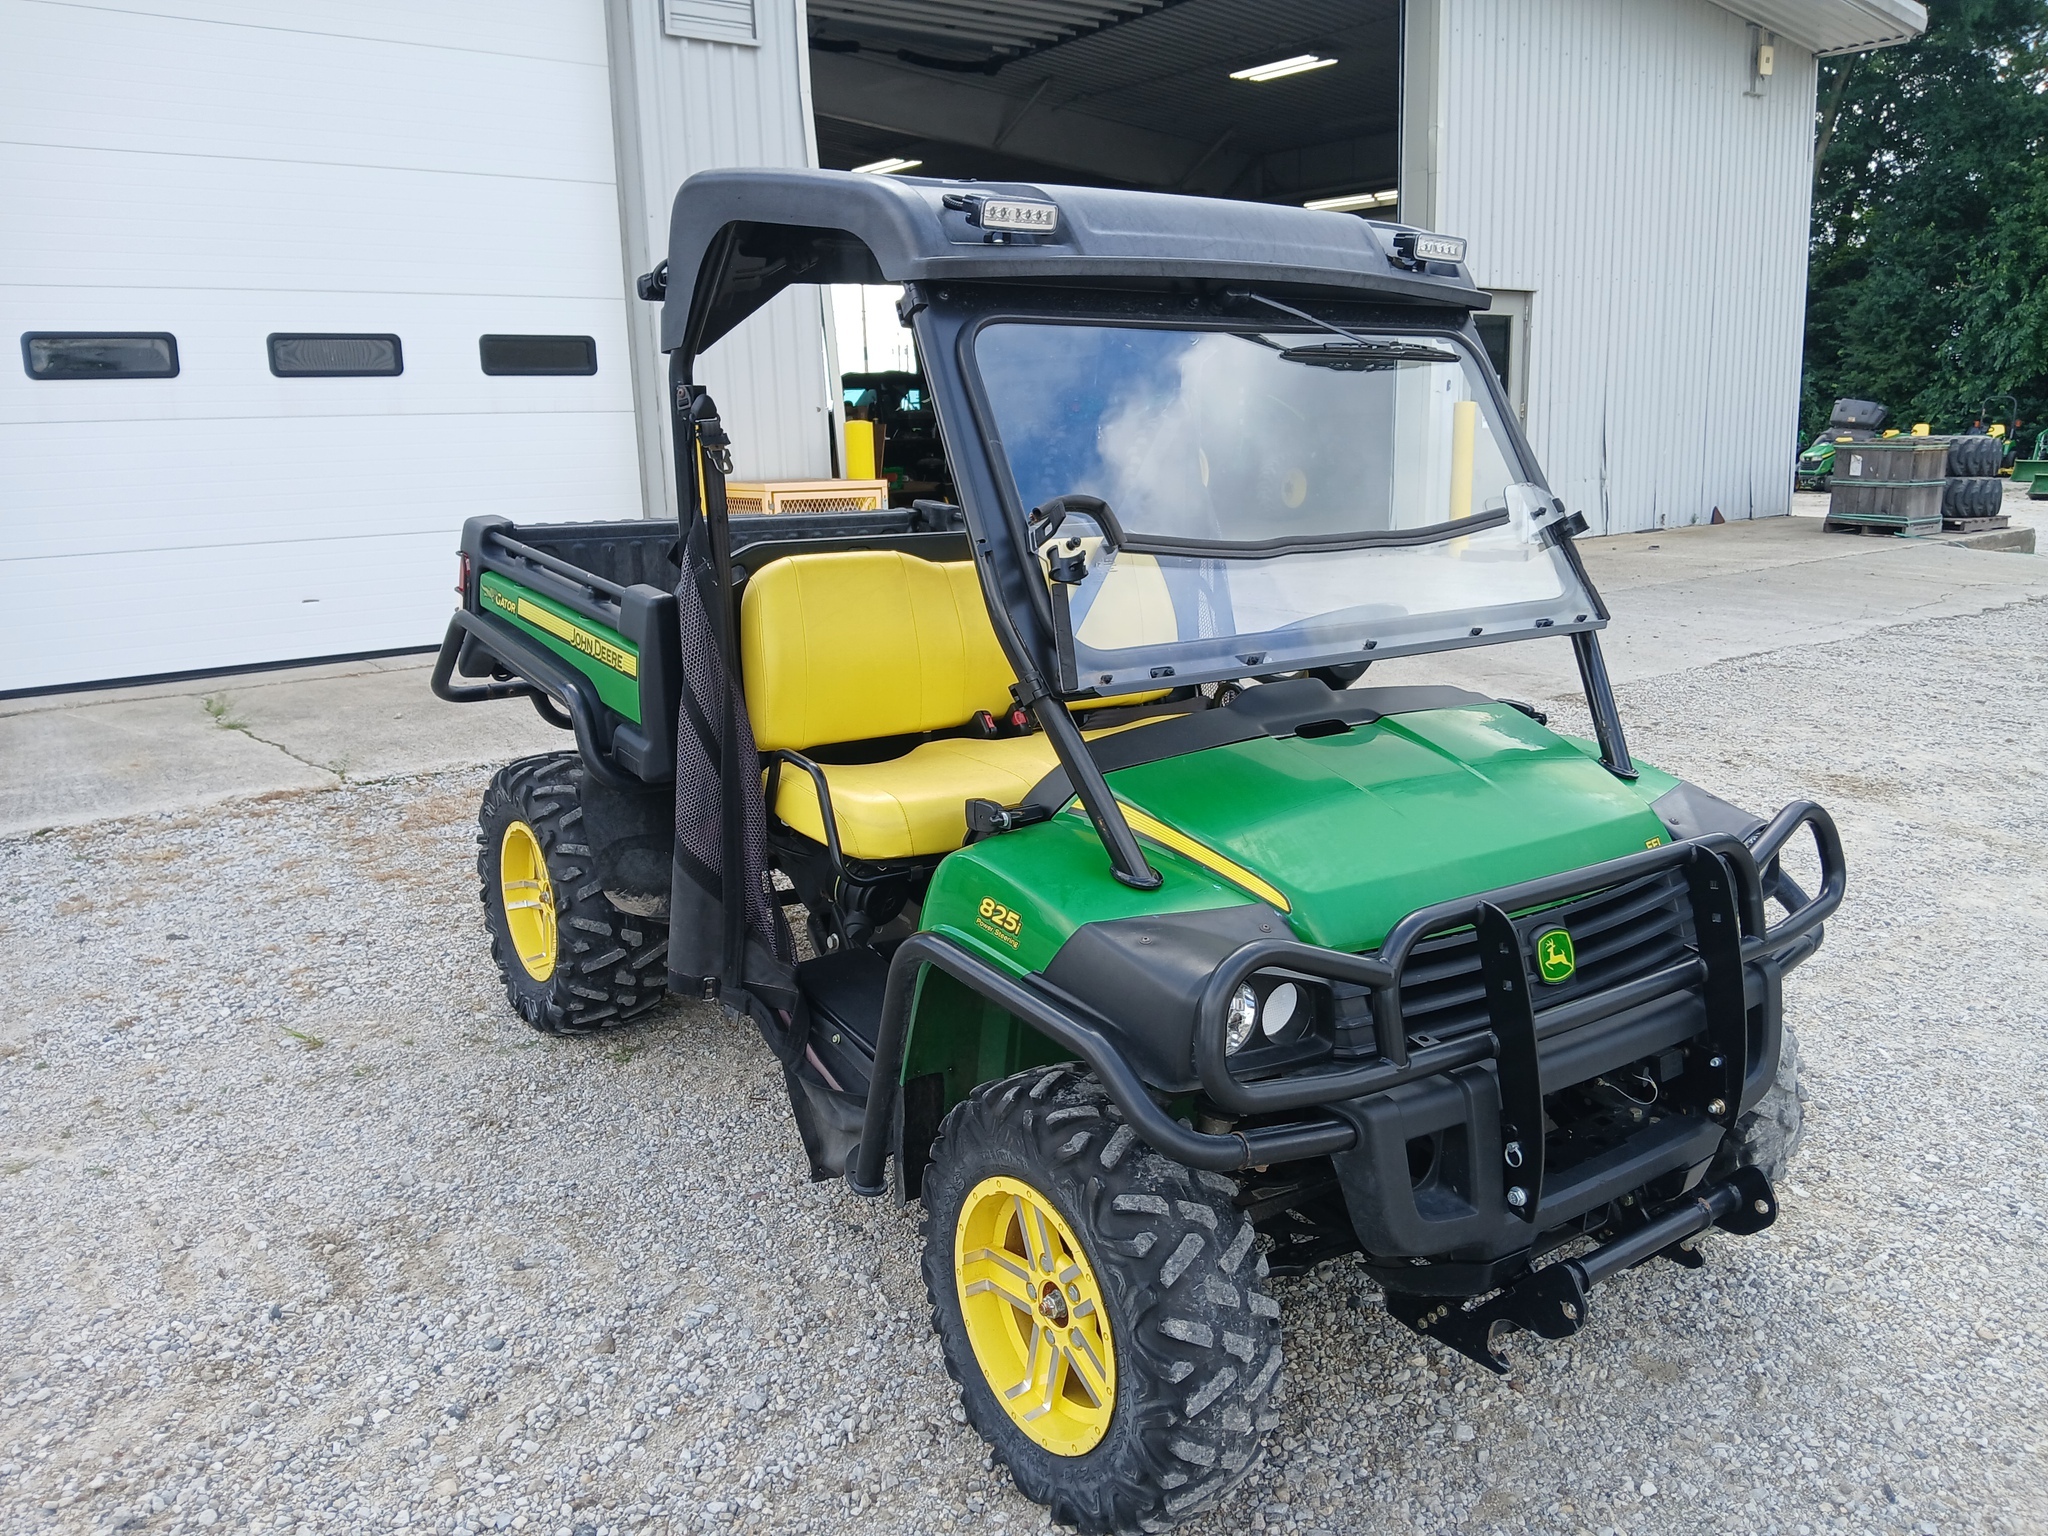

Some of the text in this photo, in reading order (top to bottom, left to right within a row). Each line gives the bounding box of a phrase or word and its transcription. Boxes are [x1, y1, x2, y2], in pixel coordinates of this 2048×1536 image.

[570, 628, 624, 669] JOHN DEERE
[975, 917, 1019, 949] Power Steering
[979, 897, 1022, 936] 825i
